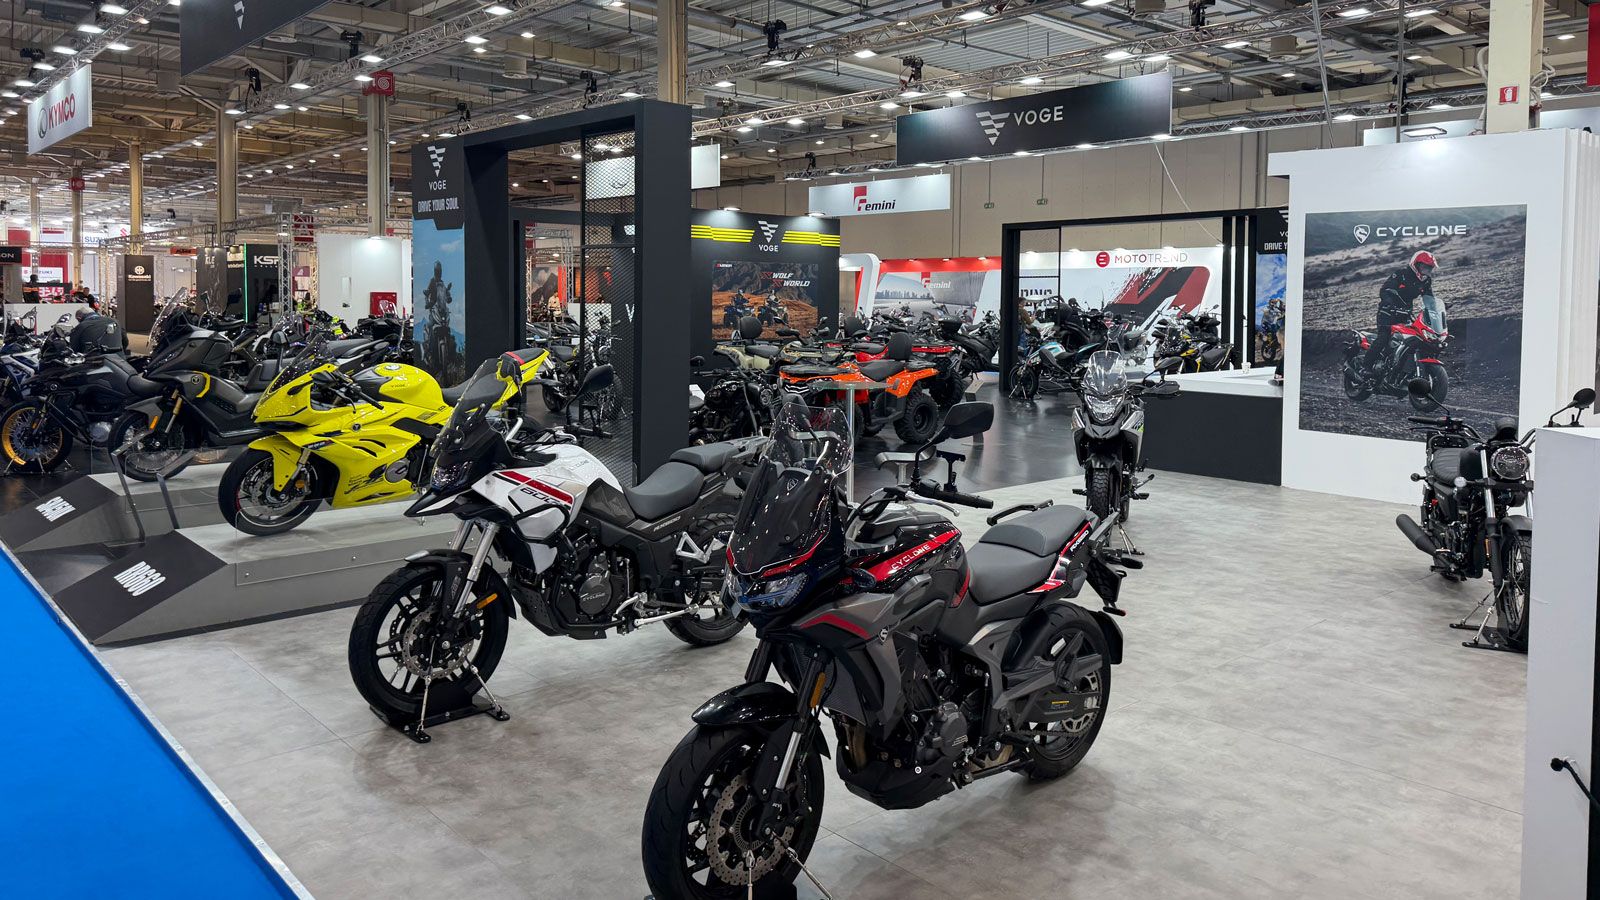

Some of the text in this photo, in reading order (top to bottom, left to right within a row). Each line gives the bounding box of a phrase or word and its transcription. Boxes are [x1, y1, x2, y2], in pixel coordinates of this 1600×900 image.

[48, 93, 76, 129] KYMCO
[1014, 105, 1064, 126] VOGE
[428, 180, 447, 192] VOGE
[417, 197, 459, 213] DRIVE YOUR SOUL
[1376, 225, 1467, 237] CYCLONE
[891, 544, 931, 570] CYCLONE
